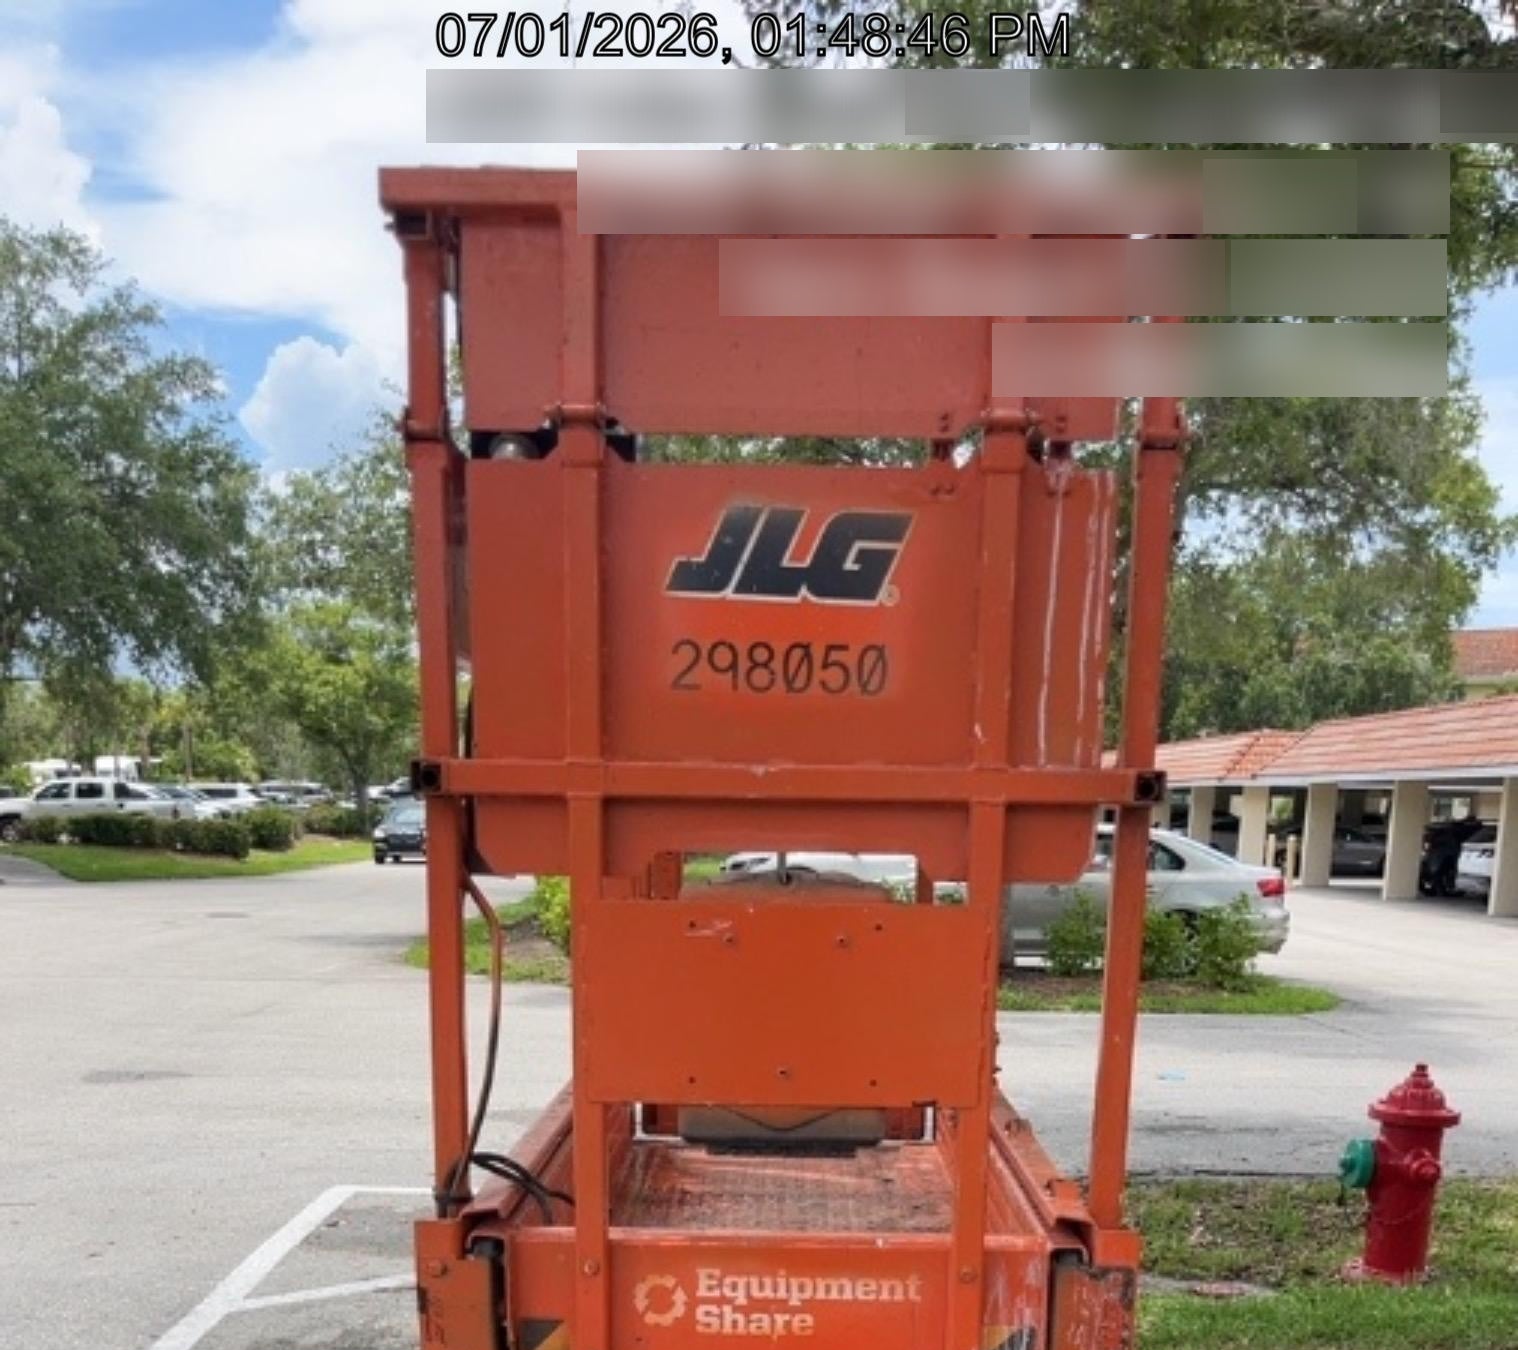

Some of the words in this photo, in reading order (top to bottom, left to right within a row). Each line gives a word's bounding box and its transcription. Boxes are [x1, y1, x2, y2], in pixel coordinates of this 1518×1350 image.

[664, 505, 915, 606] JLG
[670, 638, 888, 695] 298050
[695, 1268, 922, 1305] Equipment
[695, 1304, 815, 1337] Share
